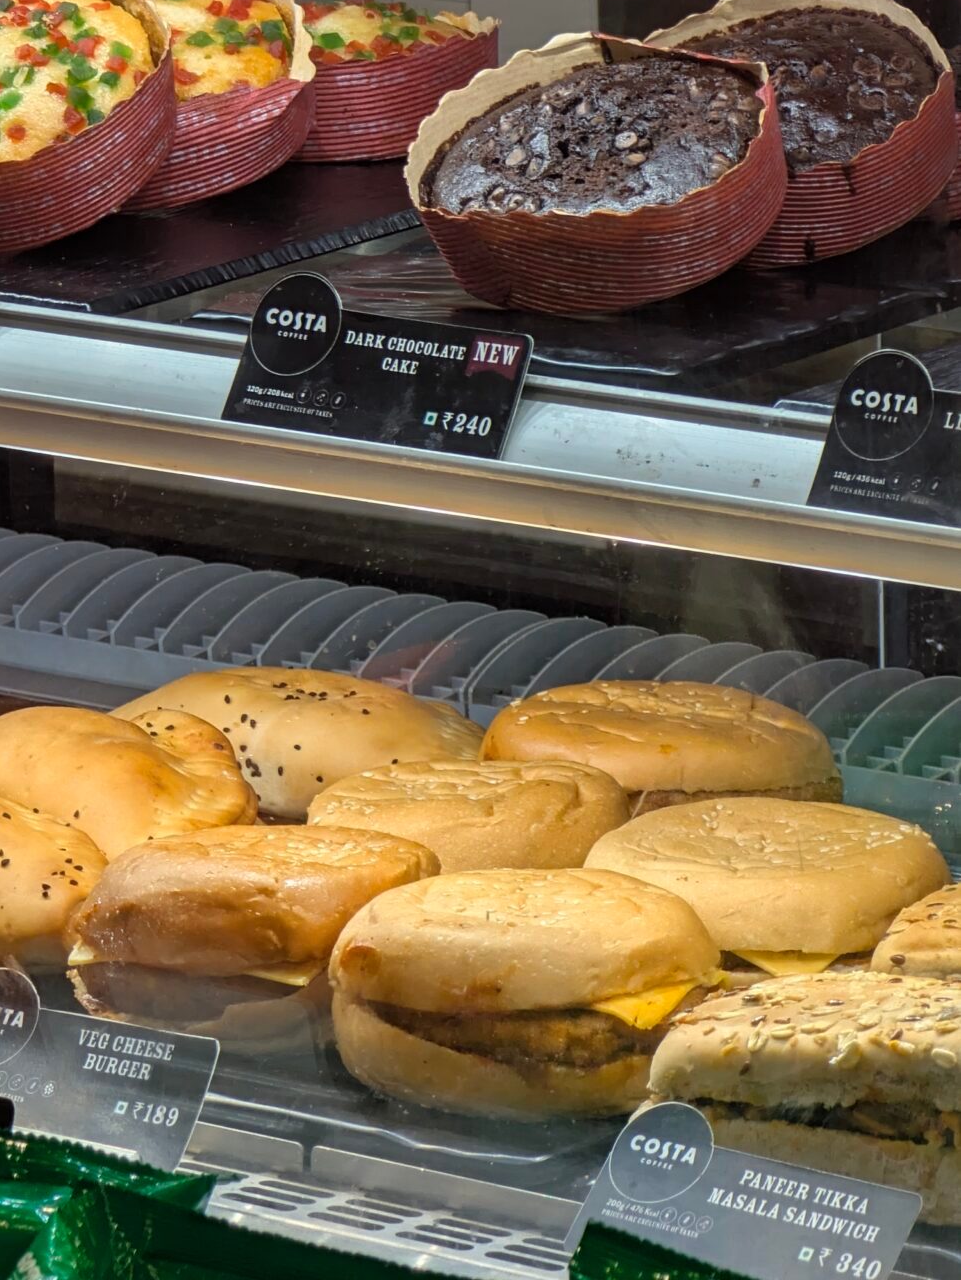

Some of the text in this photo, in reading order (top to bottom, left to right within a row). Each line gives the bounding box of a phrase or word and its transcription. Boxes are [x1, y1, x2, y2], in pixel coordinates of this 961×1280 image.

[266, 307, 327, 333] COSTA
[277, 330, 308, 341] COFFEE
[345, 330, 466, 361] DARK CHOCOLATE
[381, 357, 420, 375] CAKE
[473, 340, 521, 367] NEW
[851, 389, 918, 415] COSTA
[442, 412, 493, 437] ₹240
[864, 412, 898, 423] COFFEE
[78, 1029, 175, 1061] VEG CHEESE
[82, 1053, 151, 1081] BURGER
[132, 1101, 180, 1127] ₹189
[630, 1134, 698, 1165] COSTA
[640, 1157, 673, 1171] COFFEE
[739, 1169, 870, 1216] PANEER TIKKA
[707, 1187, 881, 1244] MASALA SANDWICH
